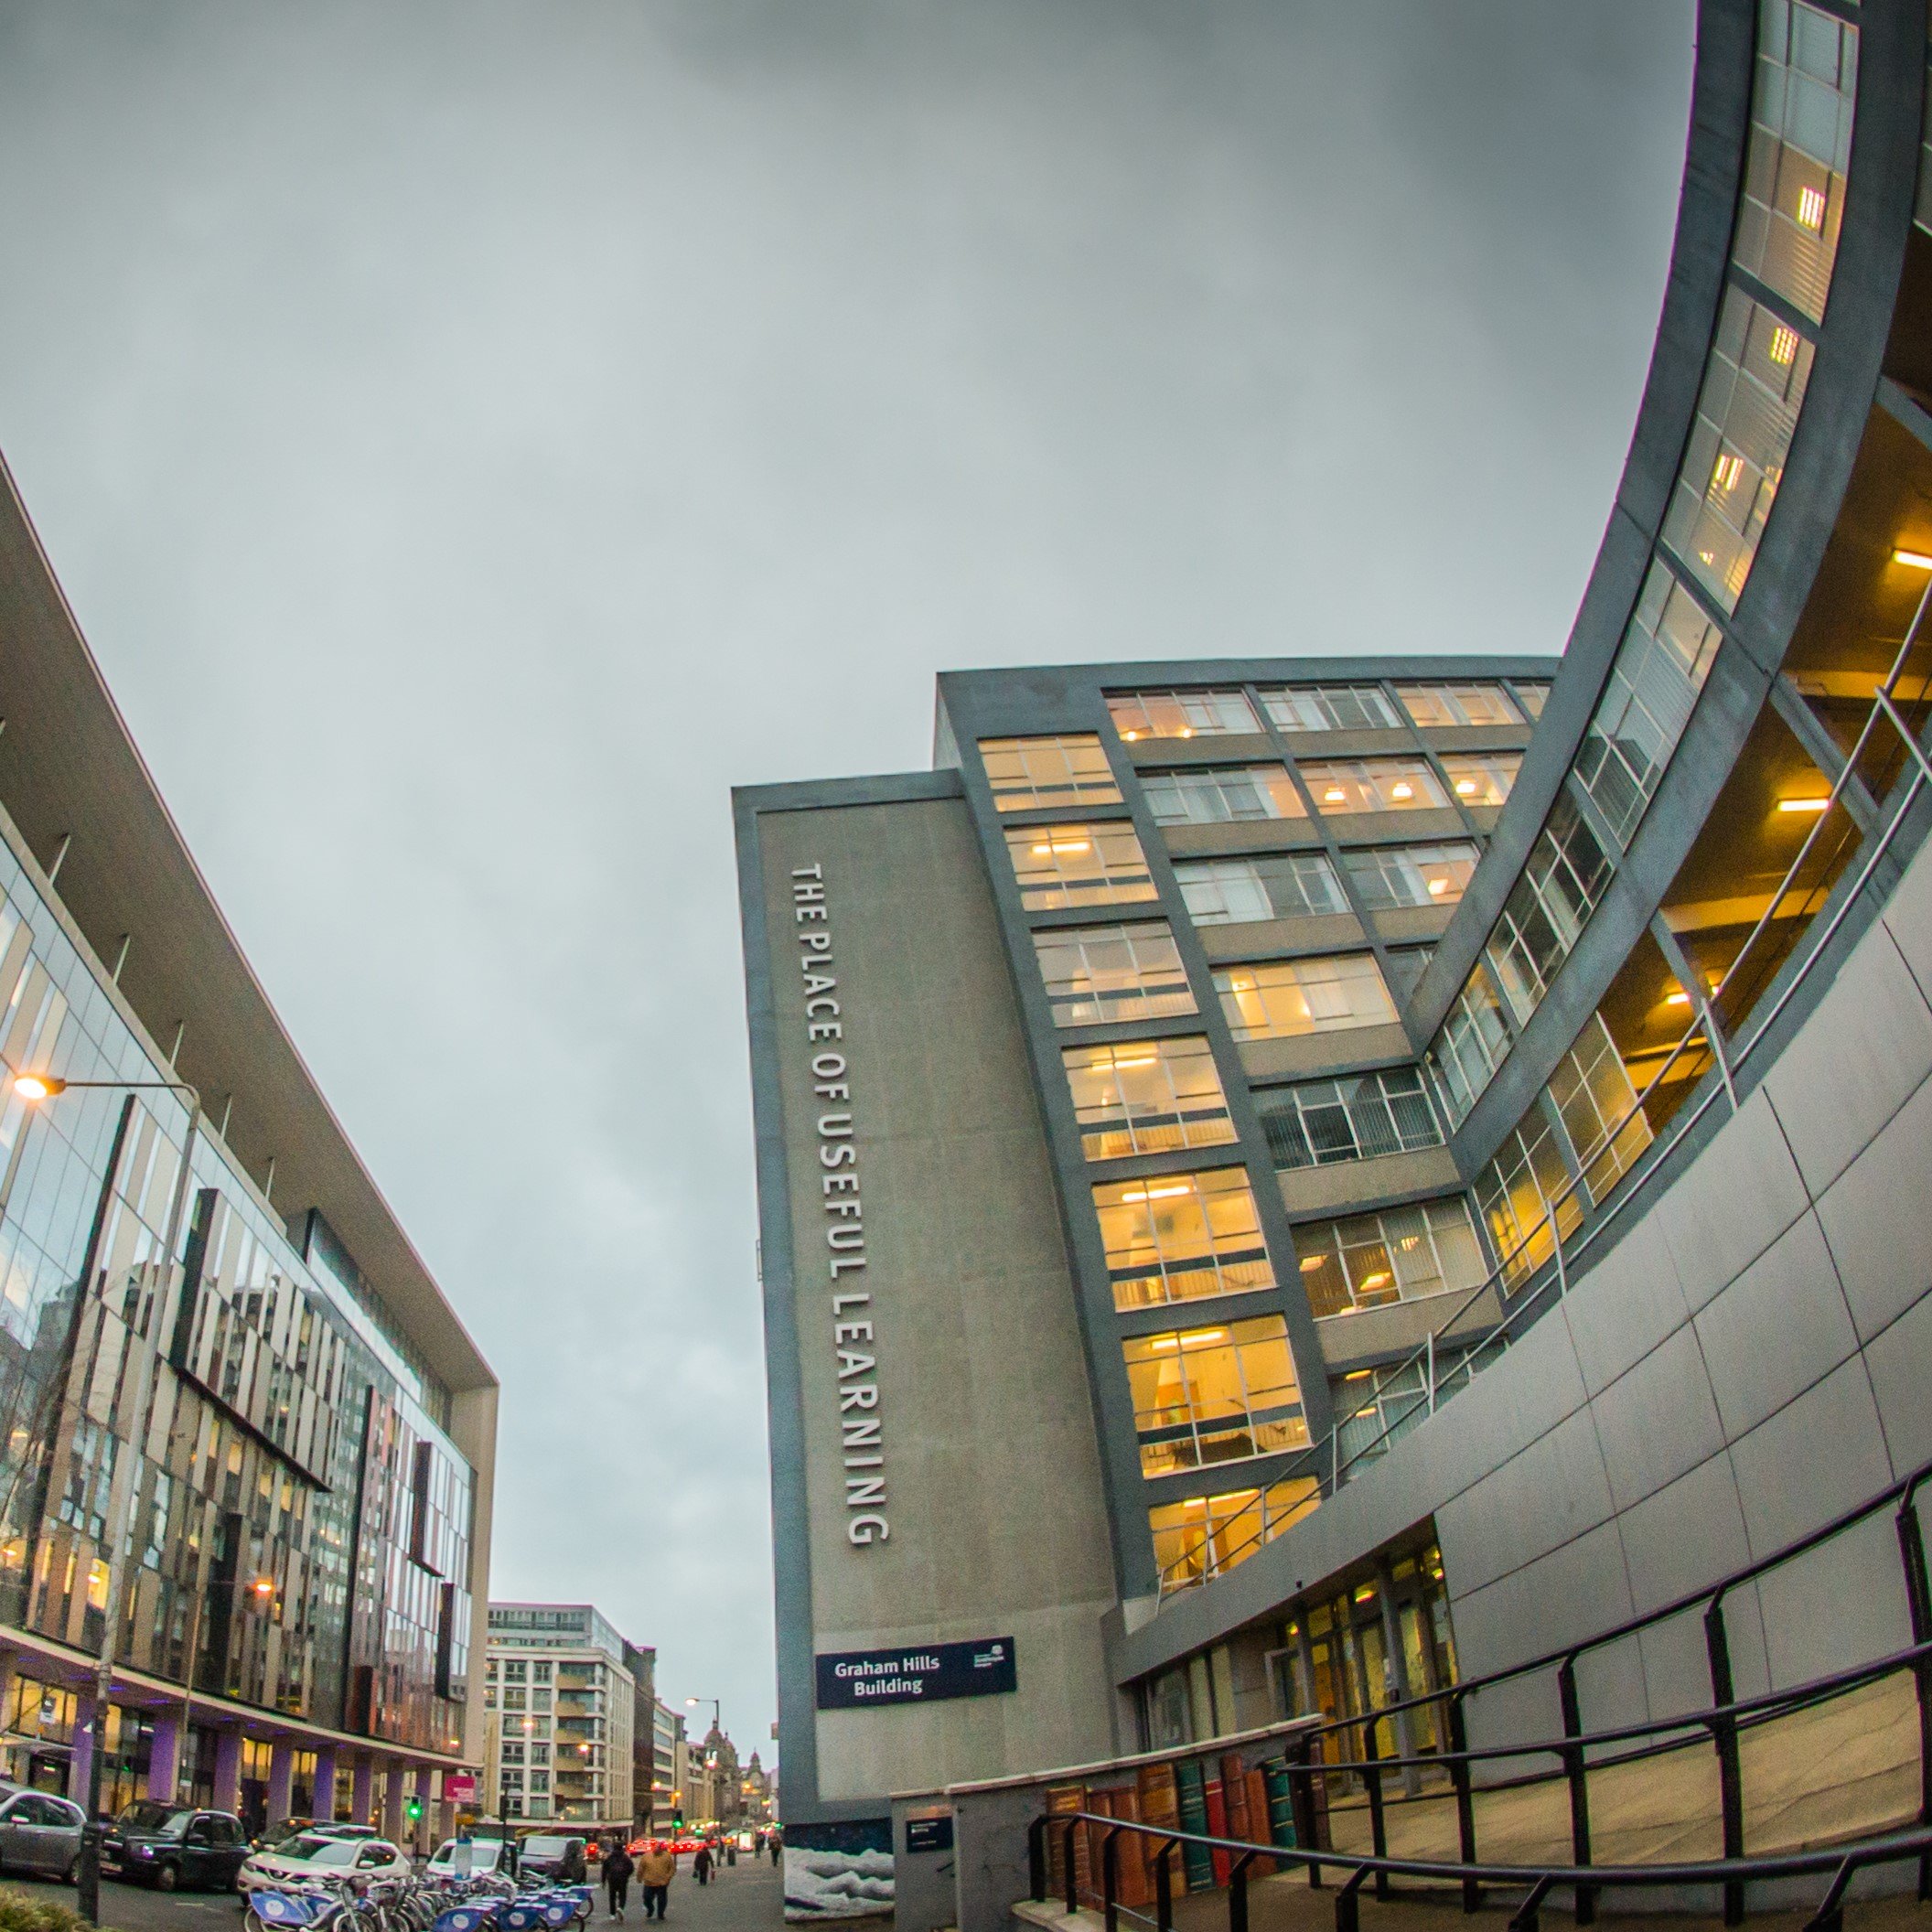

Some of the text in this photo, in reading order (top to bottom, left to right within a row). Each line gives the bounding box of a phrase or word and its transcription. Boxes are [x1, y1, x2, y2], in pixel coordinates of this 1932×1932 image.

[791, 863, 889, 1544] THE PLACE OF USEFUL LEARNING
[834, 1655, 940, 1678] Graham Hills
[854, 1678, 923, 1696] Building
